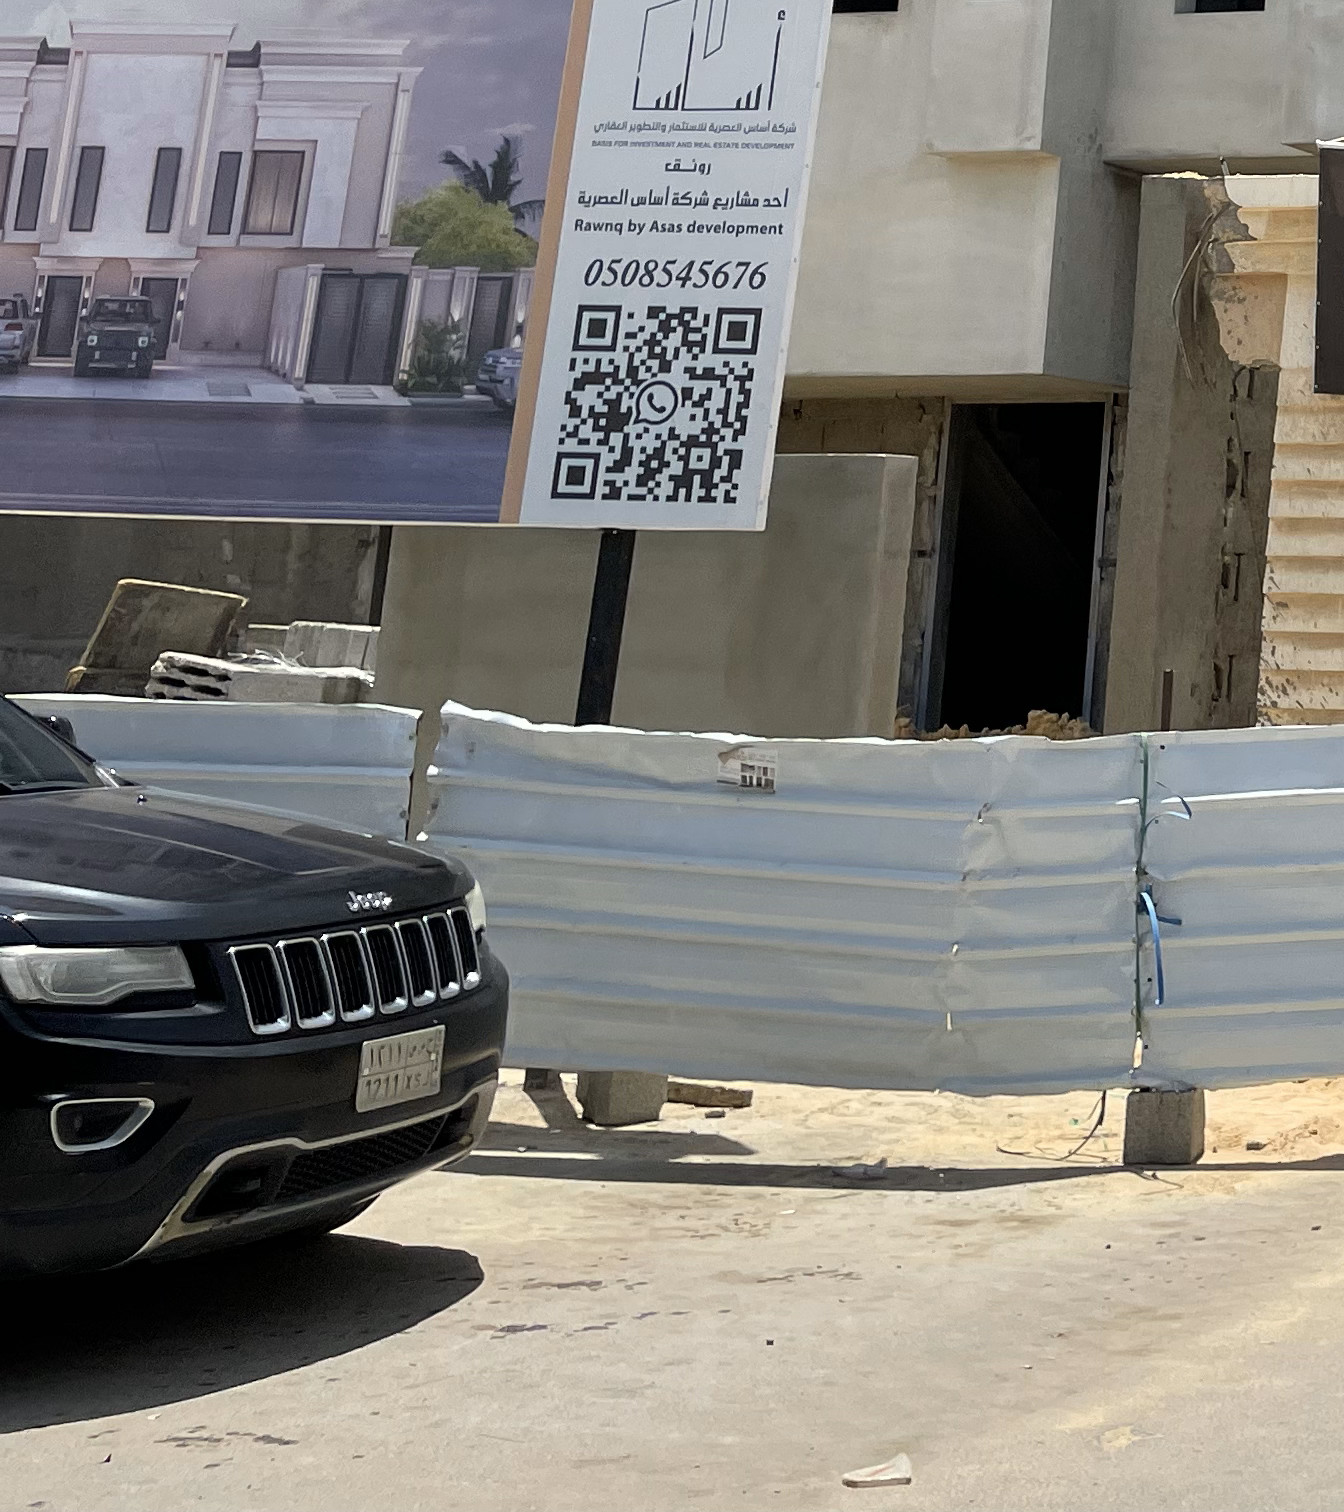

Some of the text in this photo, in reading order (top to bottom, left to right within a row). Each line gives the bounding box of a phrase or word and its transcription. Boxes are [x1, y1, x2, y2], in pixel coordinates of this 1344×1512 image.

[708, 122, 742, 134] العصرية
[743, 120, 771, 135] أساس
[771, 121, 797, 135] شركة
[740, 142, 795, 150] DEVELOPMENT
[664, 158, 712, 176] رونق
[577, 188, 629, 208] العصرية
[630, 185, 671, 207] أساس
[671, 190, 710, 209] شركة
[712, 190, 759, 211] مشاريع
[574, 218, 784, 237] Rawnq by Asas development
[583, 257, 769, 291] 0508545676
[346, 890, 393, 912] Jeep
